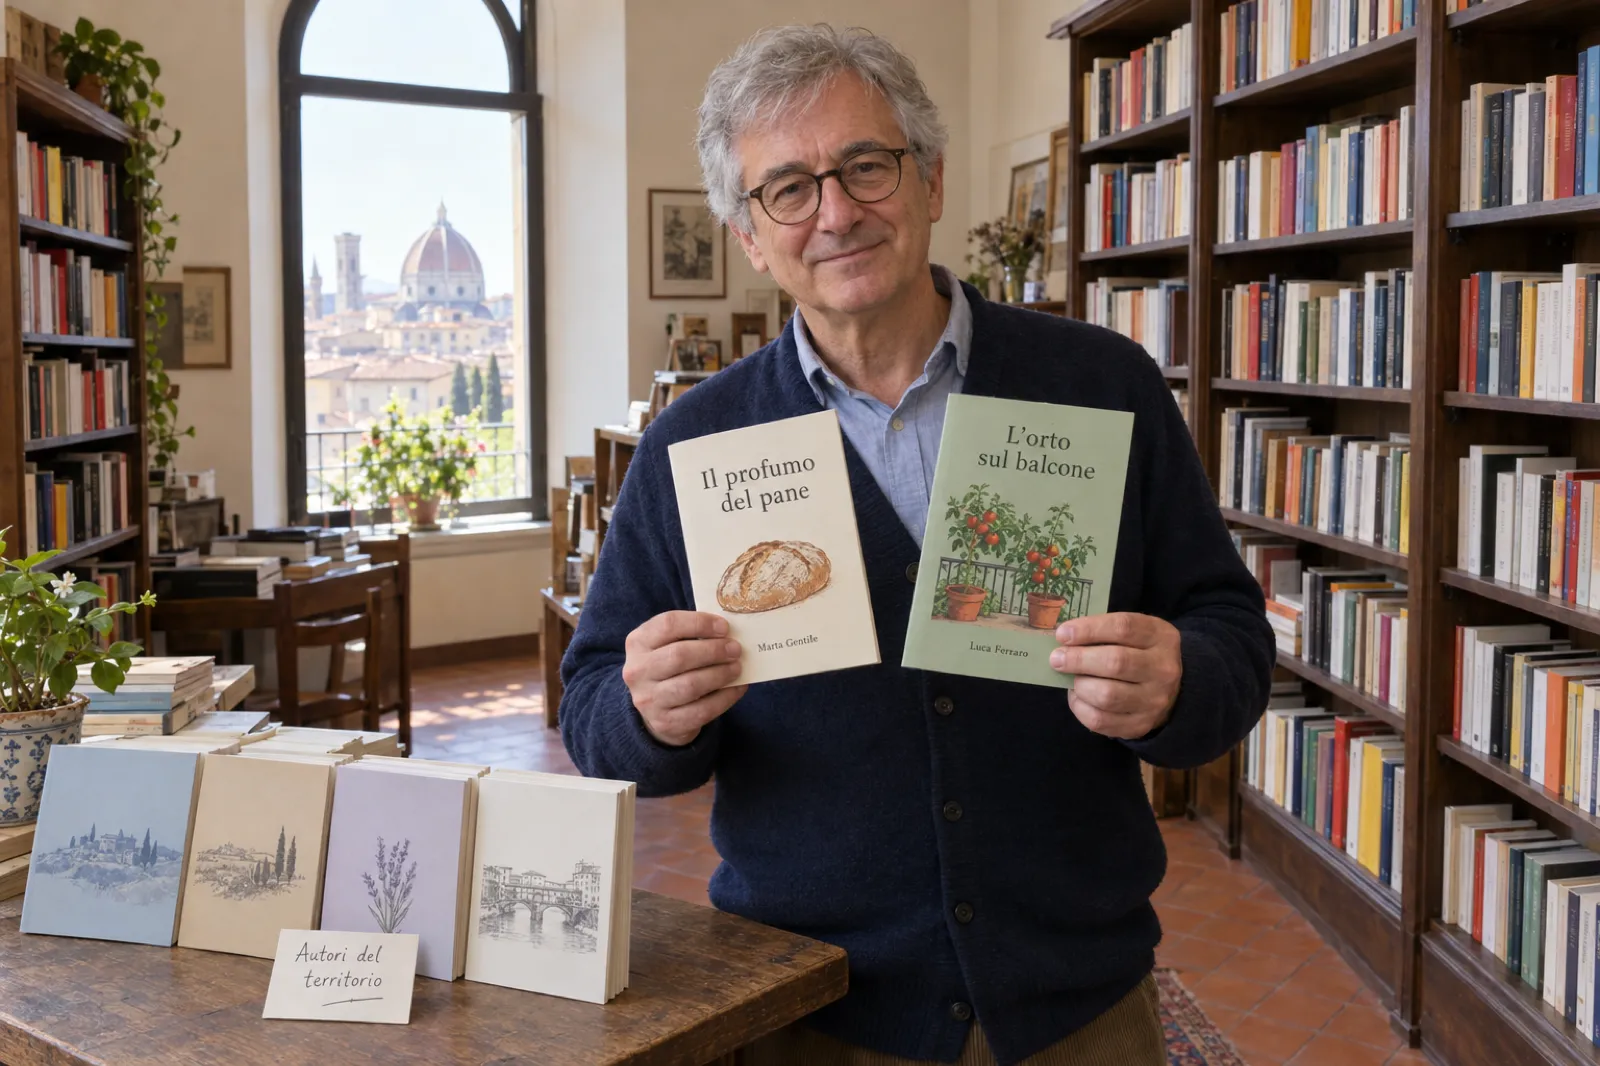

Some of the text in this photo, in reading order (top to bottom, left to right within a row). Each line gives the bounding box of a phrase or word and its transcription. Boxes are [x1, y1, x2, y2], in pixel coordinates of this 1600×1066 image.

[700, 457, 816, 491] Il profumo
[977, 449, 1096, 480] sul balcone
[721, 485, 810, 513] del pane
[757, 634, 819, 653] Marta Gentile
[969, 640, 1029, 658] Luca Ferraro
[295, 941, 383, 964] Autori del
[303, 969, 383, 989] territorio
